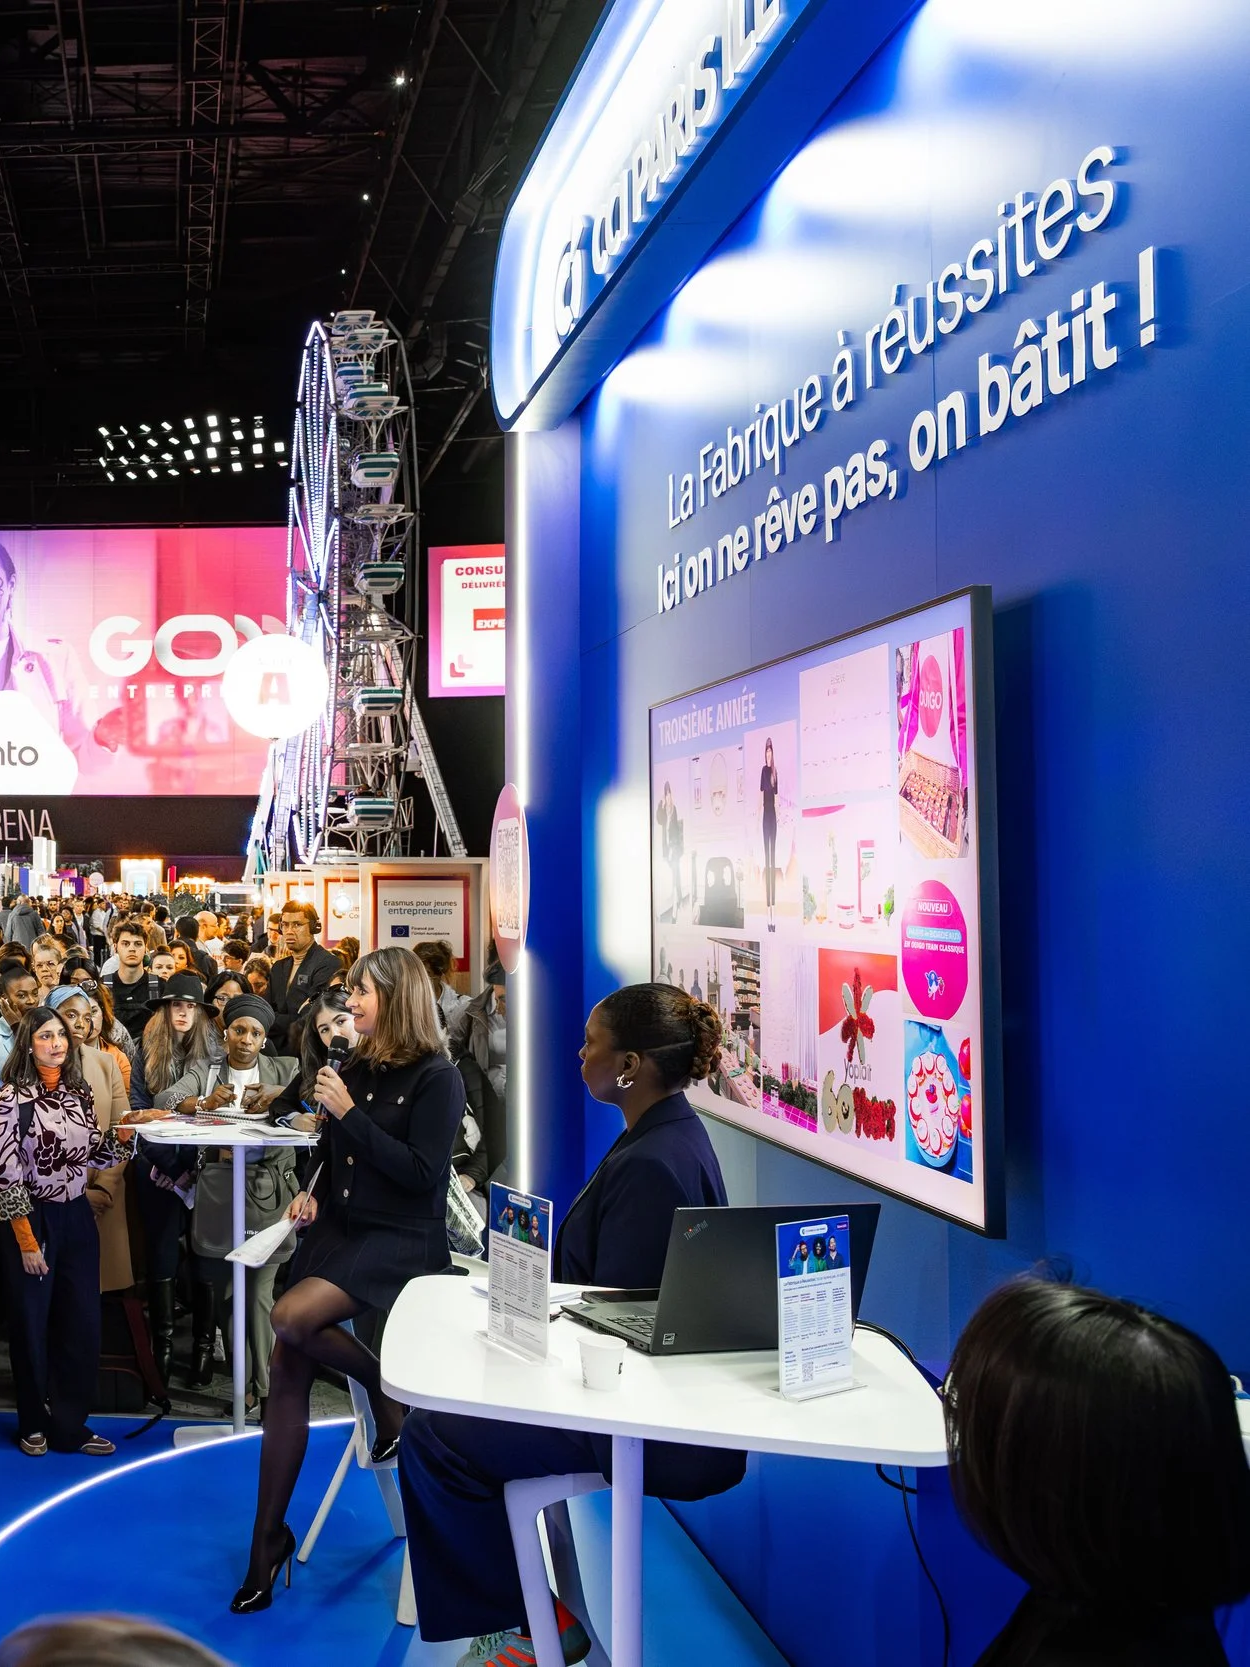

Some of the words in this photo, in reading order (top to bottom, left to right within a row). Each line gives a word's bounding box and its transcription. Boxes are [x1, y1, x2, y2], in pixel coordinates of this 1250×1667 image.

[592, 169, 632, 274] CCI
[631, 34, 718, 223] PARIS
[668, 473, 696, 529] La
[700, 375, 823, 507] Fabrique
[831, 330, 853, 412] à
[865, 145, 1115, 389] réussites
[658, 553, 682, 614] Ici
[684, 546, 713, 599] on
[718, 525, 750, 581] ne
[754, 486, 818, 561] rêve
[824, 439, 898, 543] pas,
[909, 391, 967, 472] on
[978, 281, 1118, 436] bâtit
[1138, 246, 1155, 347] !
[658, 704, 714, 747] TROISIÈME
[716, 684, 757, 732] ANNÉE
[388, 907, 453, 916] entrepreneurs
[917, 901, 948, 913] NOUVEAU
